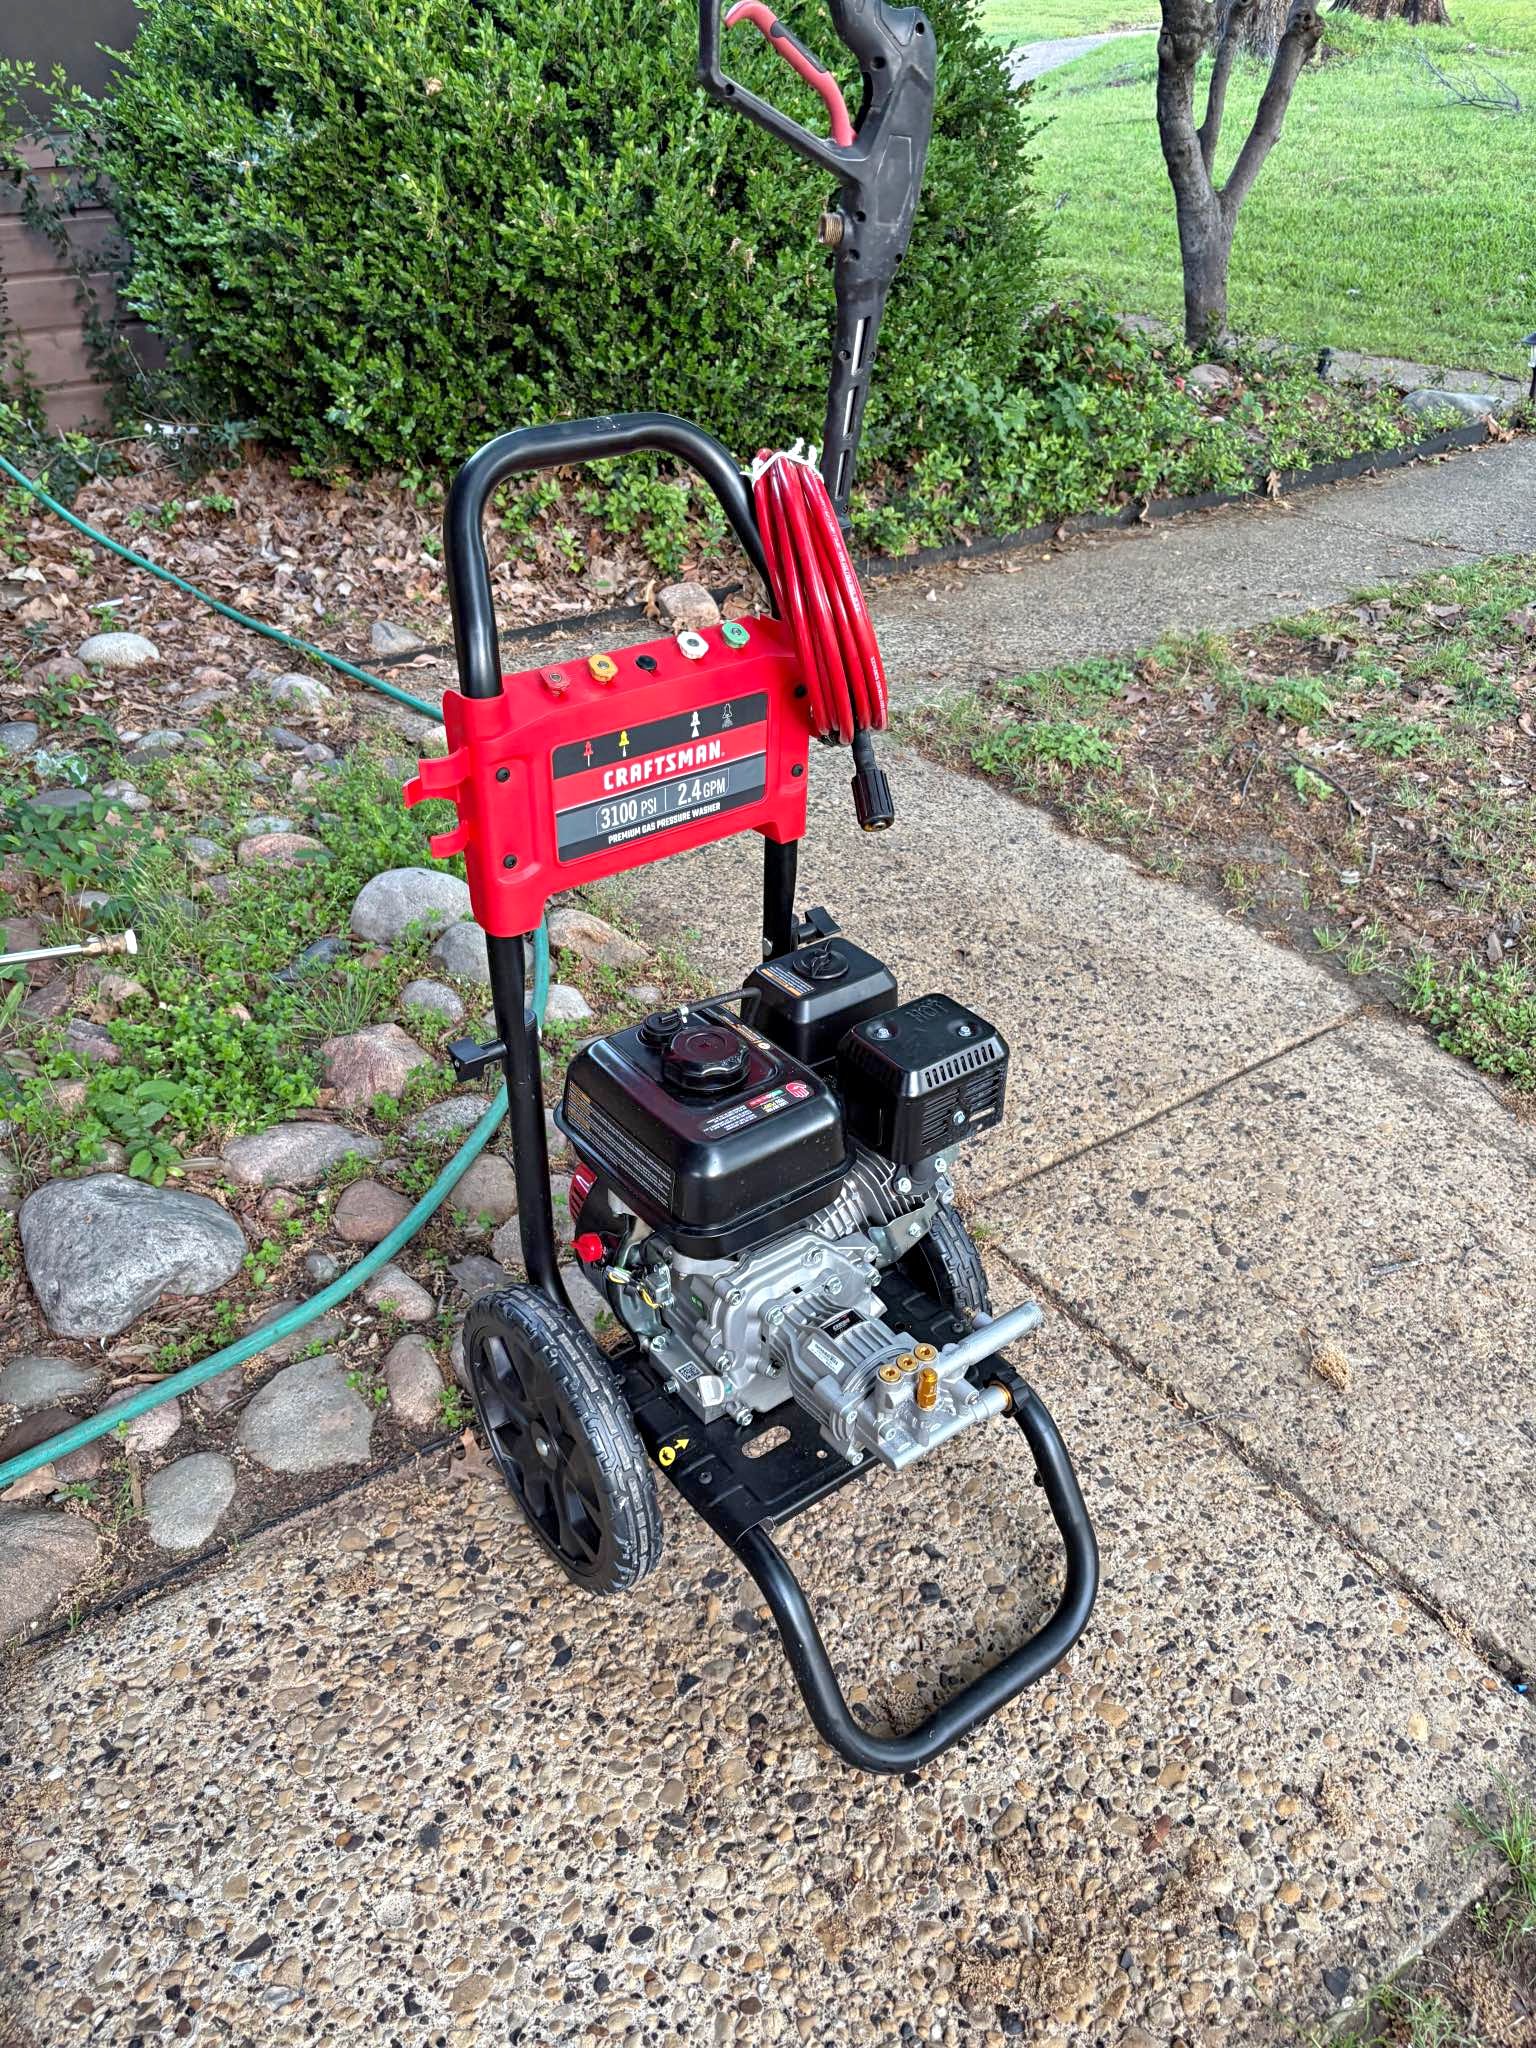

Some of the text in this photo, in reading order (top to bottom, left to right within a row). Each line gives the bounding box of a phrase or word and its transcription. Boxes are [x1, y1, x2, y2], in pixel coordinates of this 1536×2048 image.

[603, 739, 721, 791] CRAFTSMAN
[601, 777, 726, 829] 3100 PSI 2.4 GPM
[608, 802, 721, 845] PREMIUM GAS PRESSURE WASHER
[905, 1000, 948, 1023] HOT
